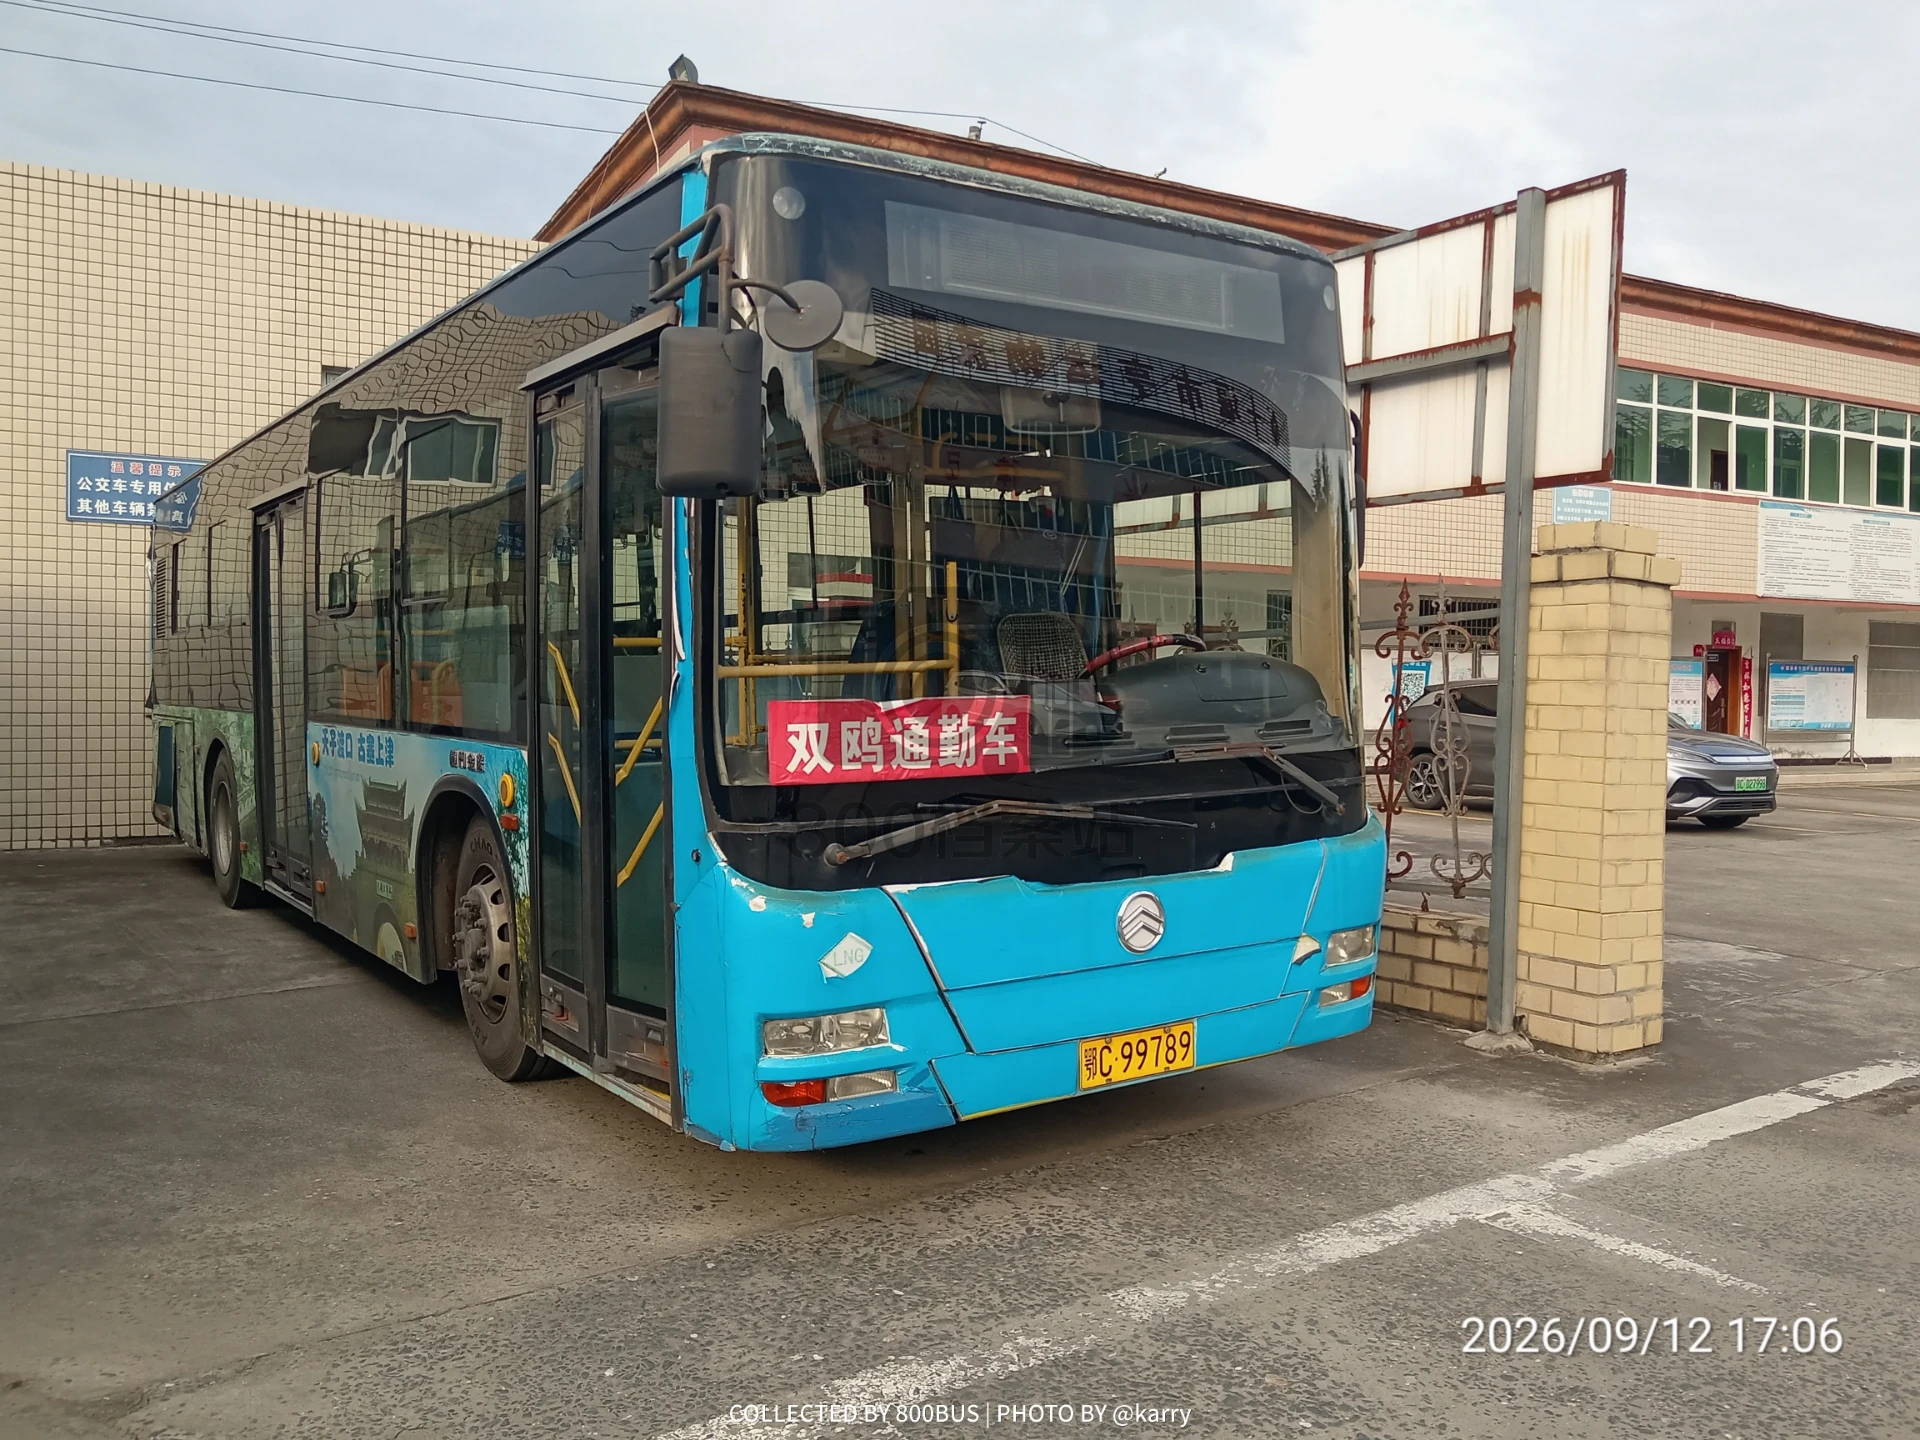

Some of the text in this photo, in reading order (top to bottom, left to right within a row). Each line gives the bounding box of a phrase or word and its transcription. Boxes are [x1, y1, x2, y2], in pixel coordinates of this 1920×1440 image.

[110, 461, 182, 477] 温馨提示
[321, 729, 353, 760] 天子渡口
[786, 711, 1019, 775] 双鸥通勤车
[833, 948, 864, 967] LNG
